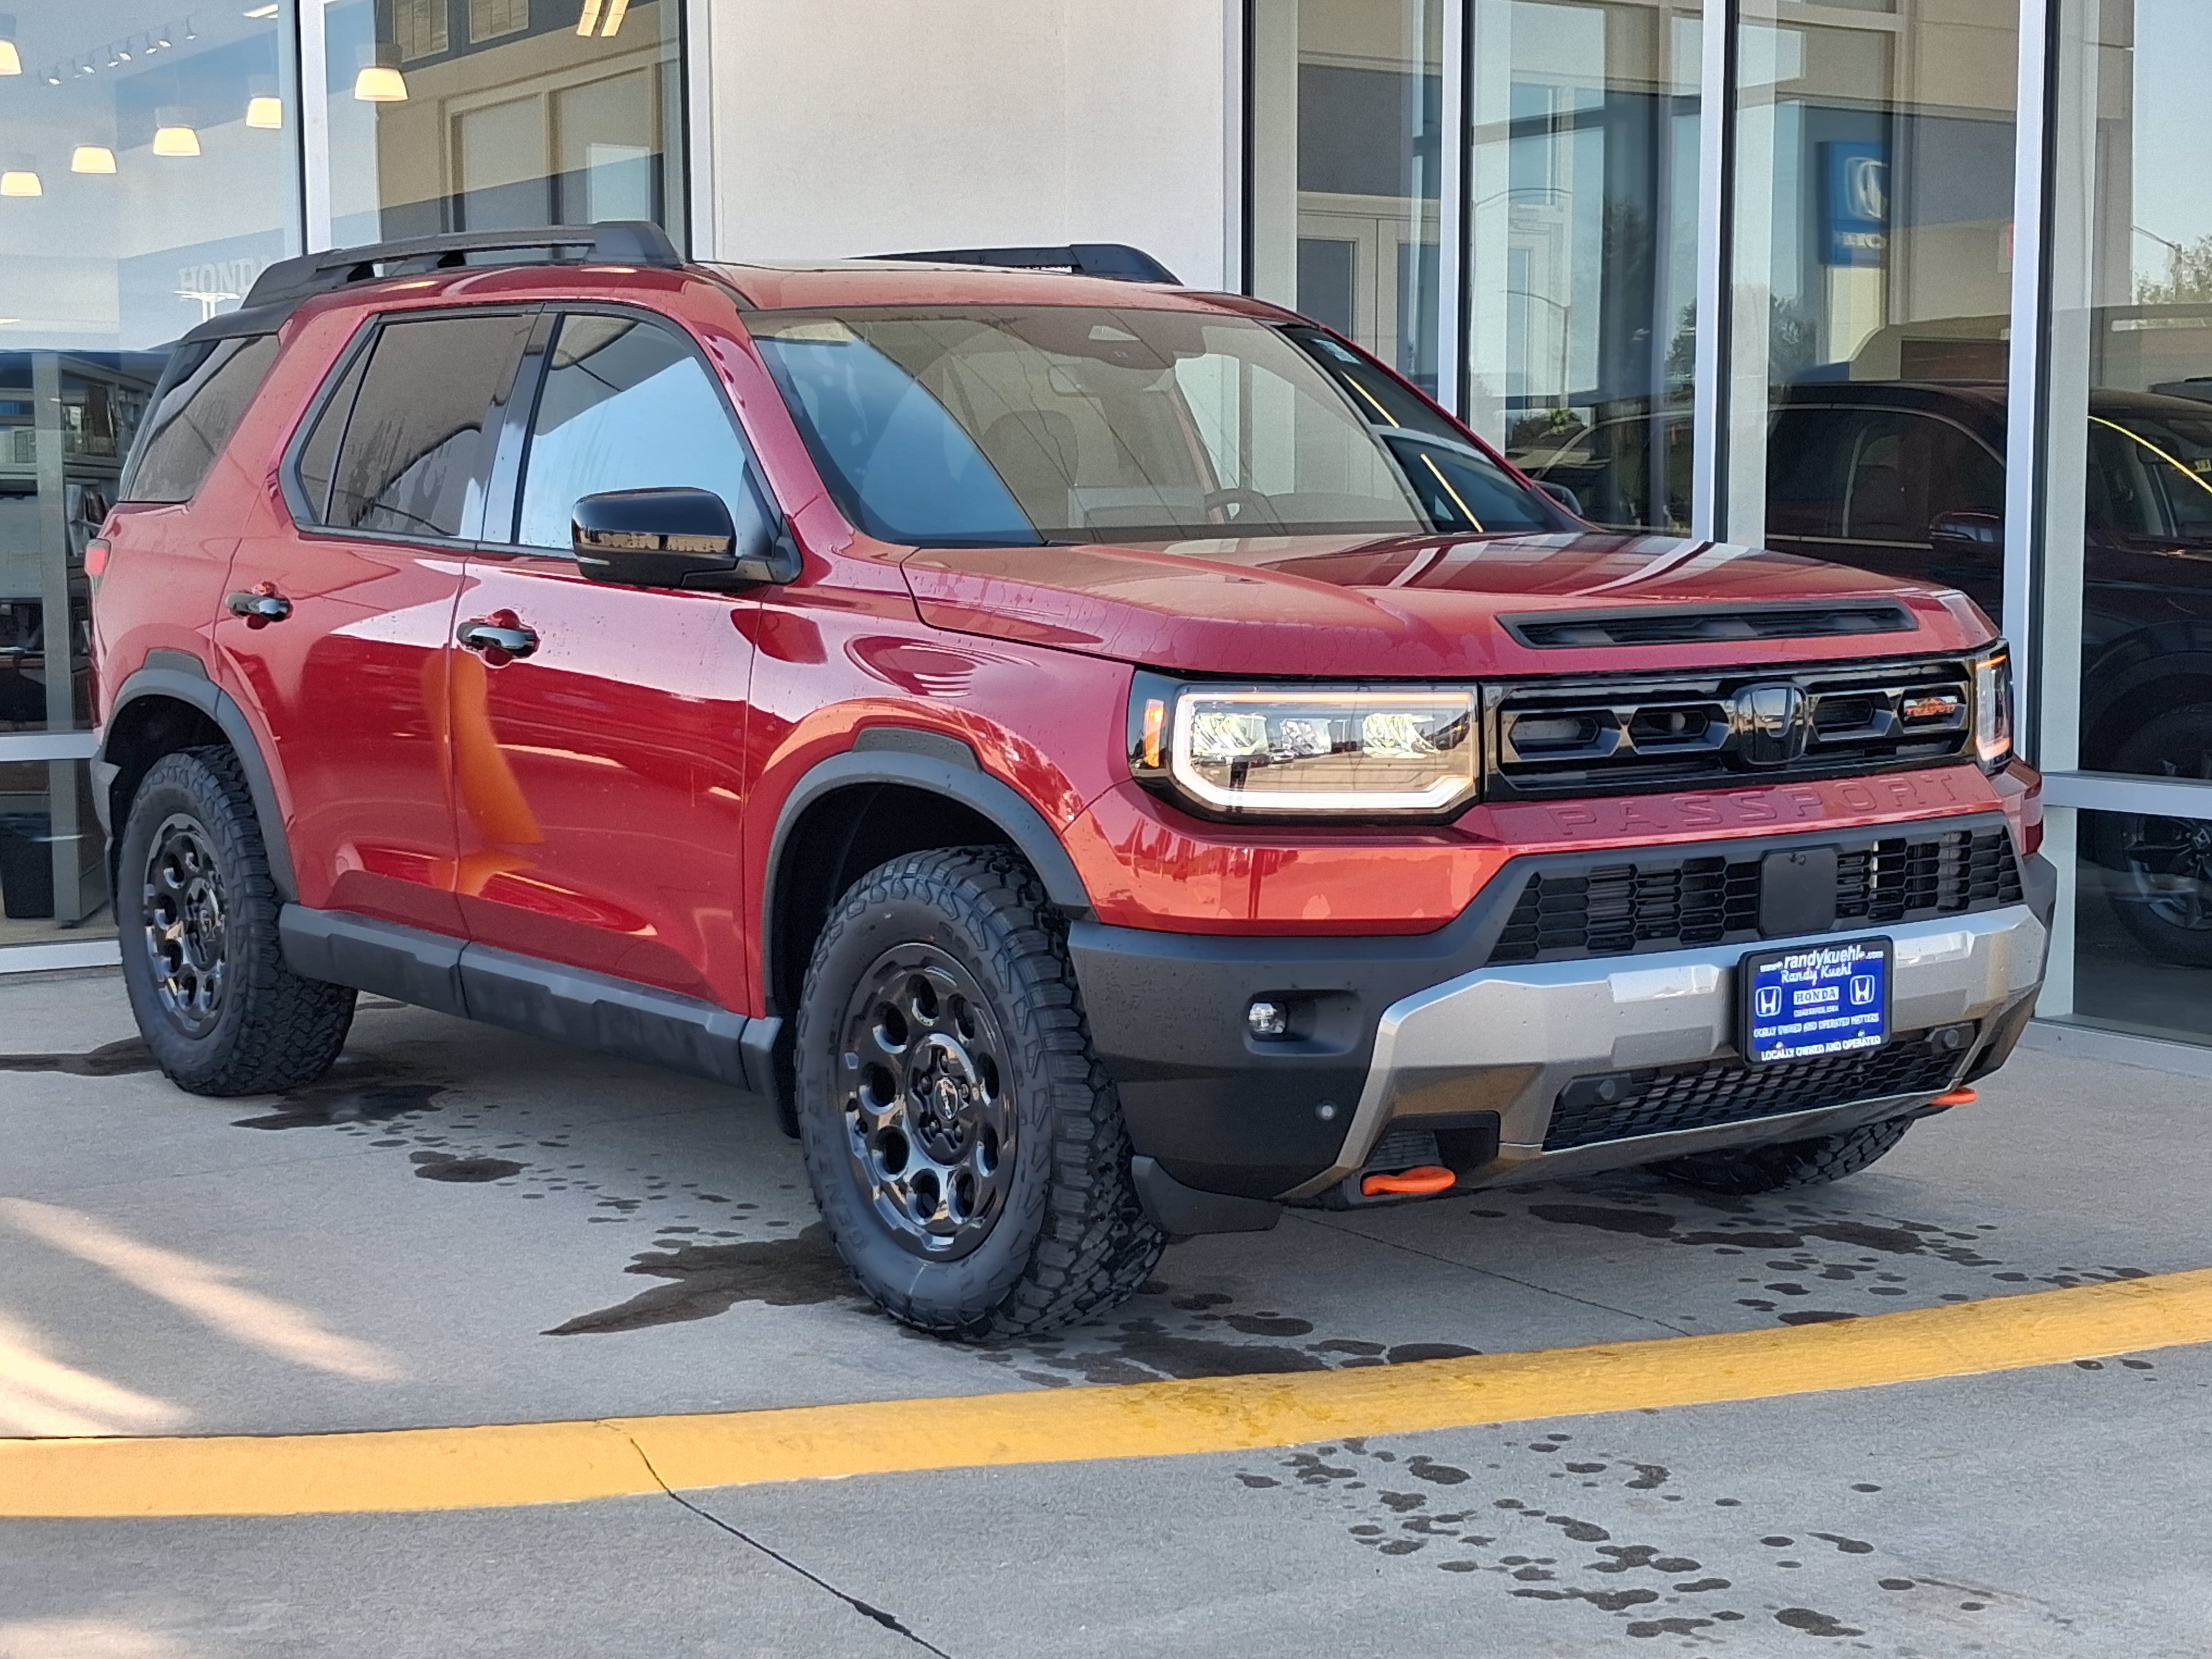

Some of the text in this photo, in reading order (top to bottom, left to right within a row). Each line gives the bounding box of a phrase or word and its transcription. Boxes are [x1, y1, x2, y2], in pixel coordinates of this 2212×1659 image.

[1546, 774, 1956, 835] PASSPORT
[1784, 944, 1861, 969] randykuehl
[1780, 962, 1852, 986] Randy Kuehl
[1796, 988, 1836, 1002] HONDA
